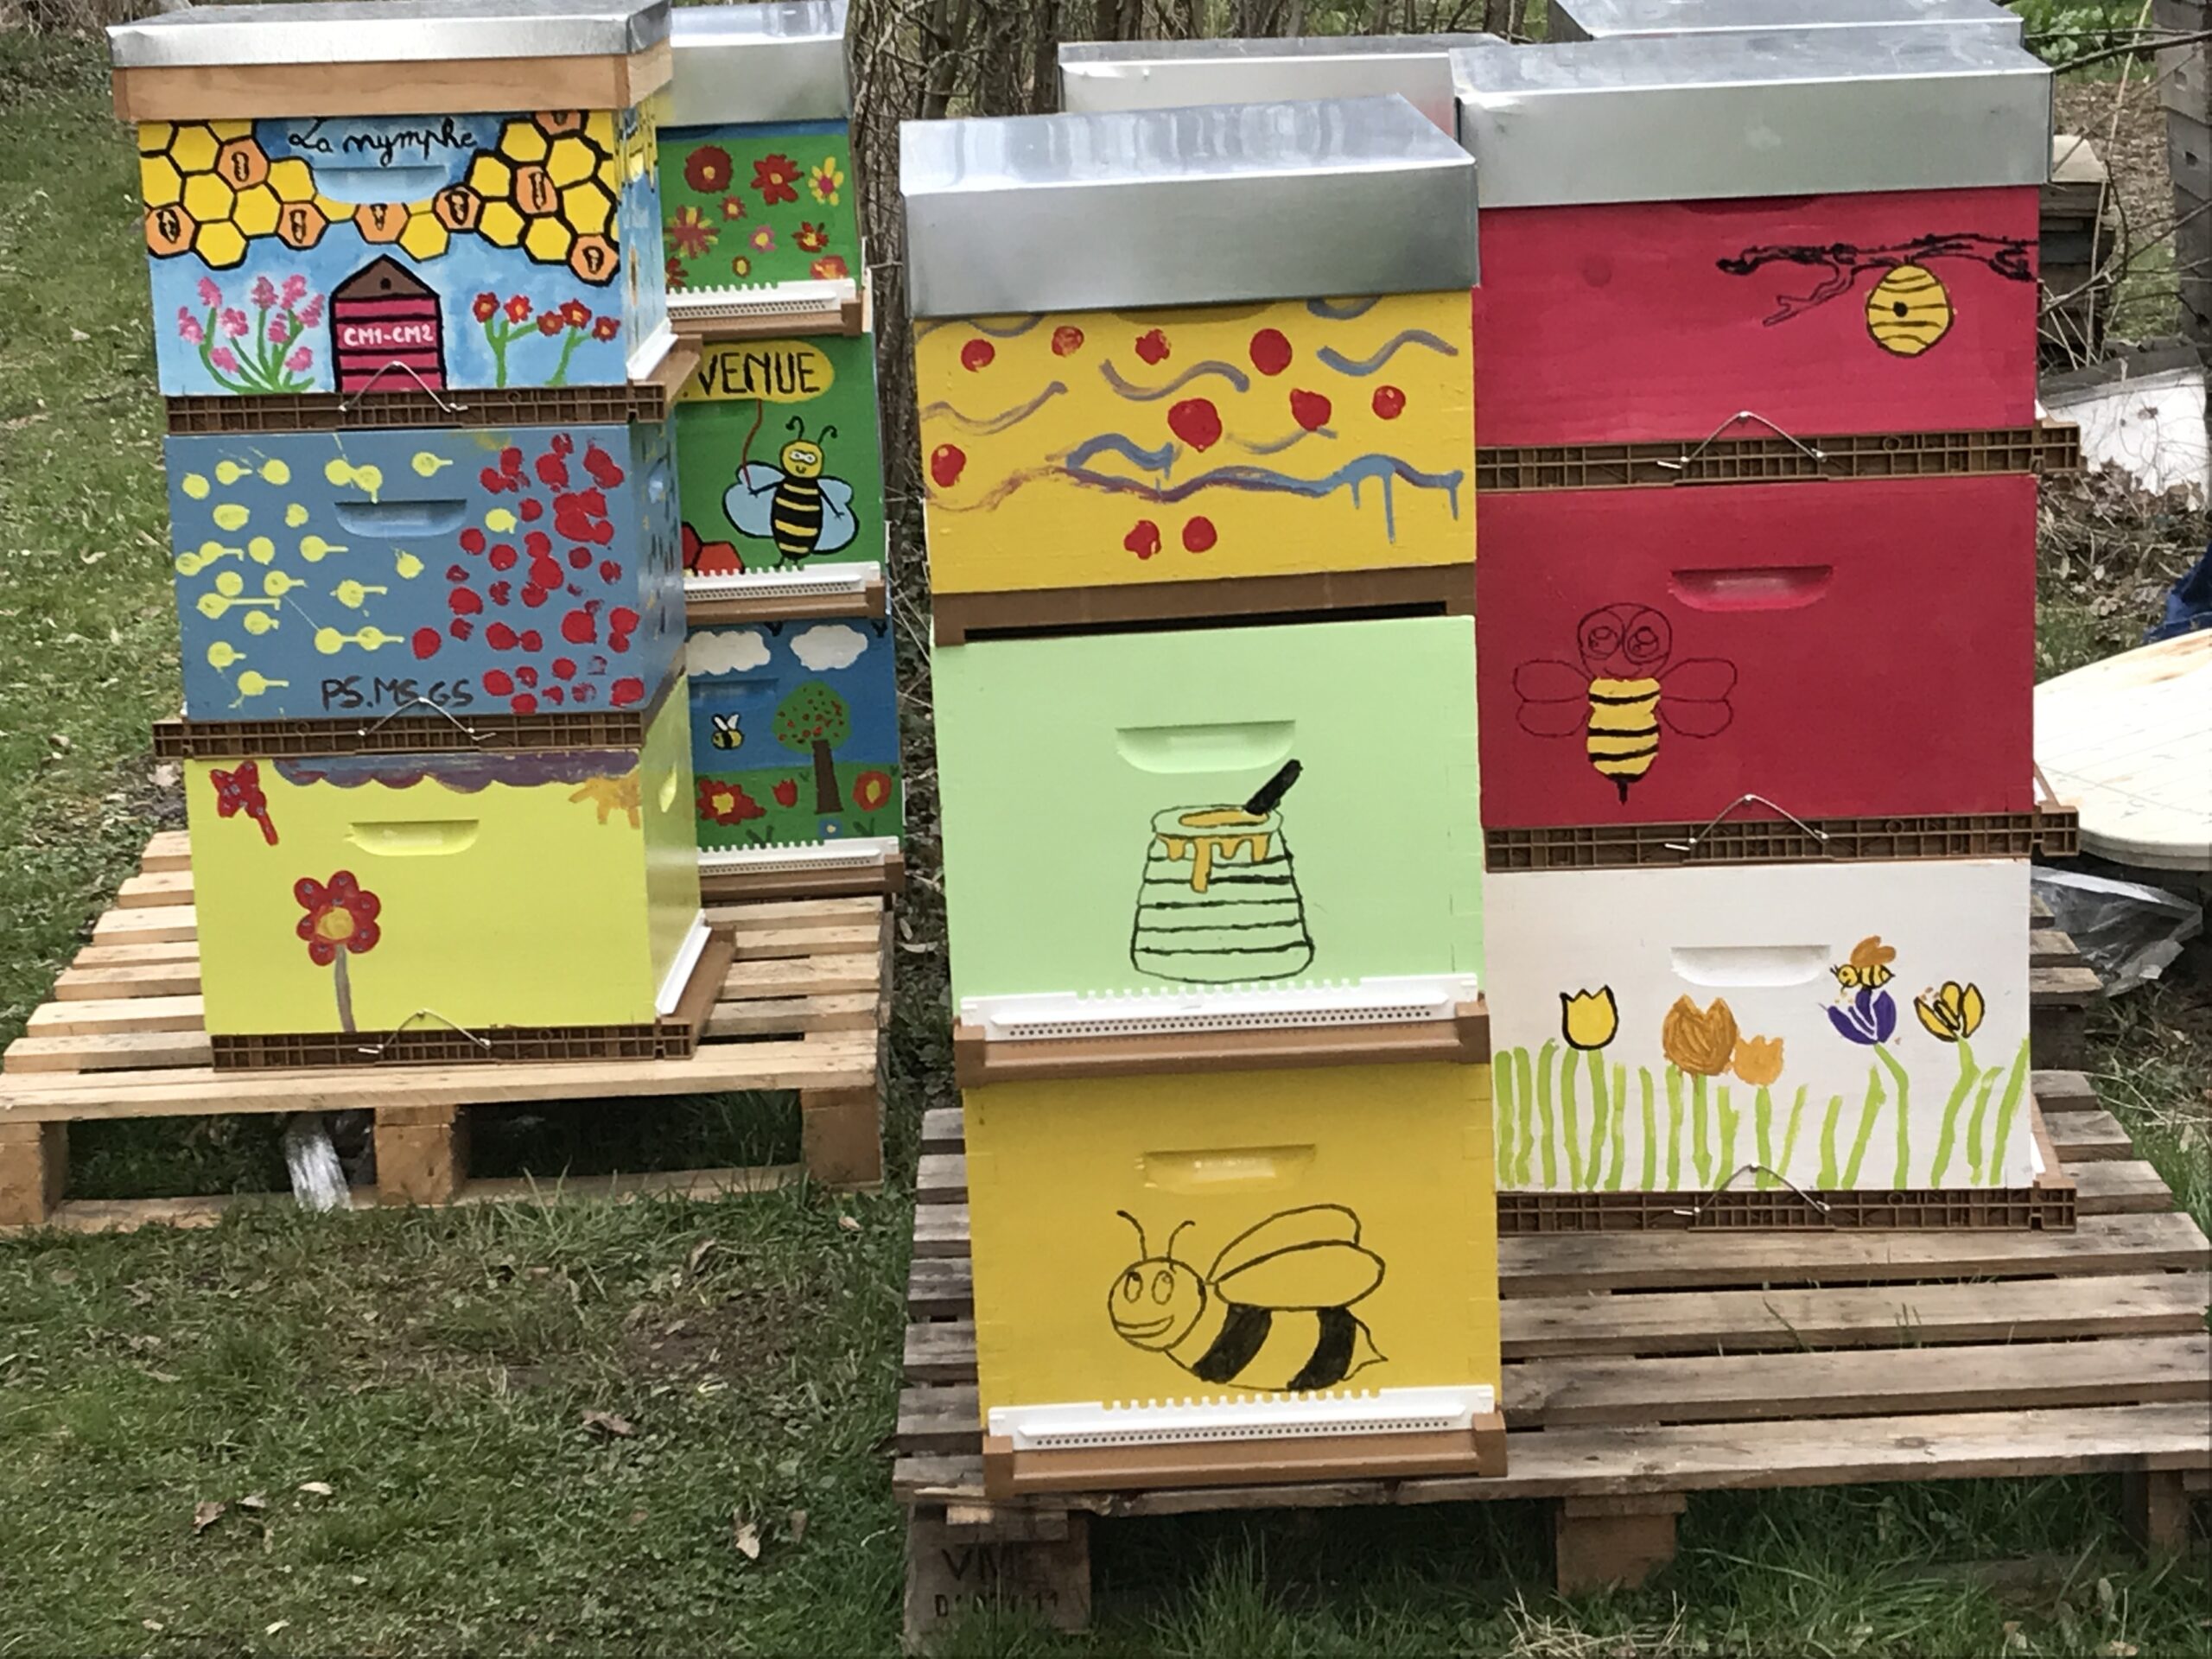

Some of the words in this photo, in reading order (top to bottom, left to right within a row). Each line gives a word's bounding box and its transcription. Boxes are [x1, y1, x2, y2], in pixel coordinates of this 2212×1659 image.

[288, 117, 333, 153] La
[343, 117, 477, 168] nymphe
[343, 324, 434, 346] CM1-CM2
